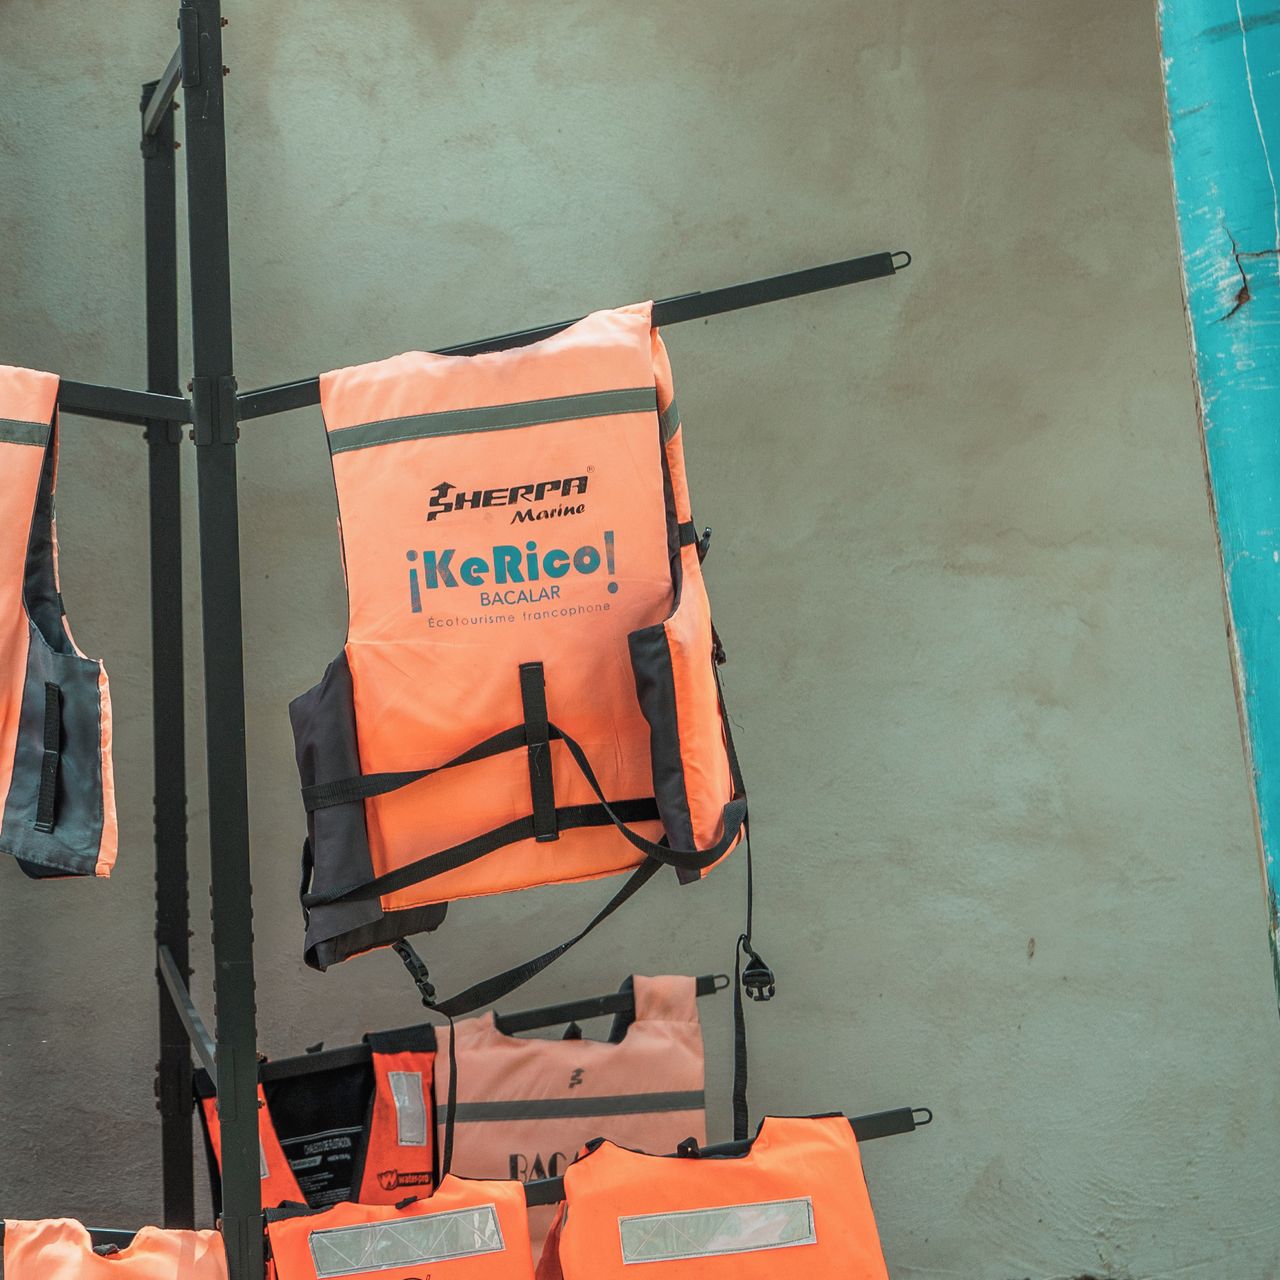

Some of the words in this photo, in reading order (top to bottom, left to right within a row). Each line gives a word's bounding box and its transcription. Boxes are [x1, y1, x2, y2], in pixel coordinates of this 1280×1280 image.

[509, 503, 586, 525] Marine
[406, 530, 619, 613] ¡KeRico!
[480, 585, 561, 607] BACALAR
[428, 614, 515, 628] Écotourisme
[522, 602, 611, 624] francophone
